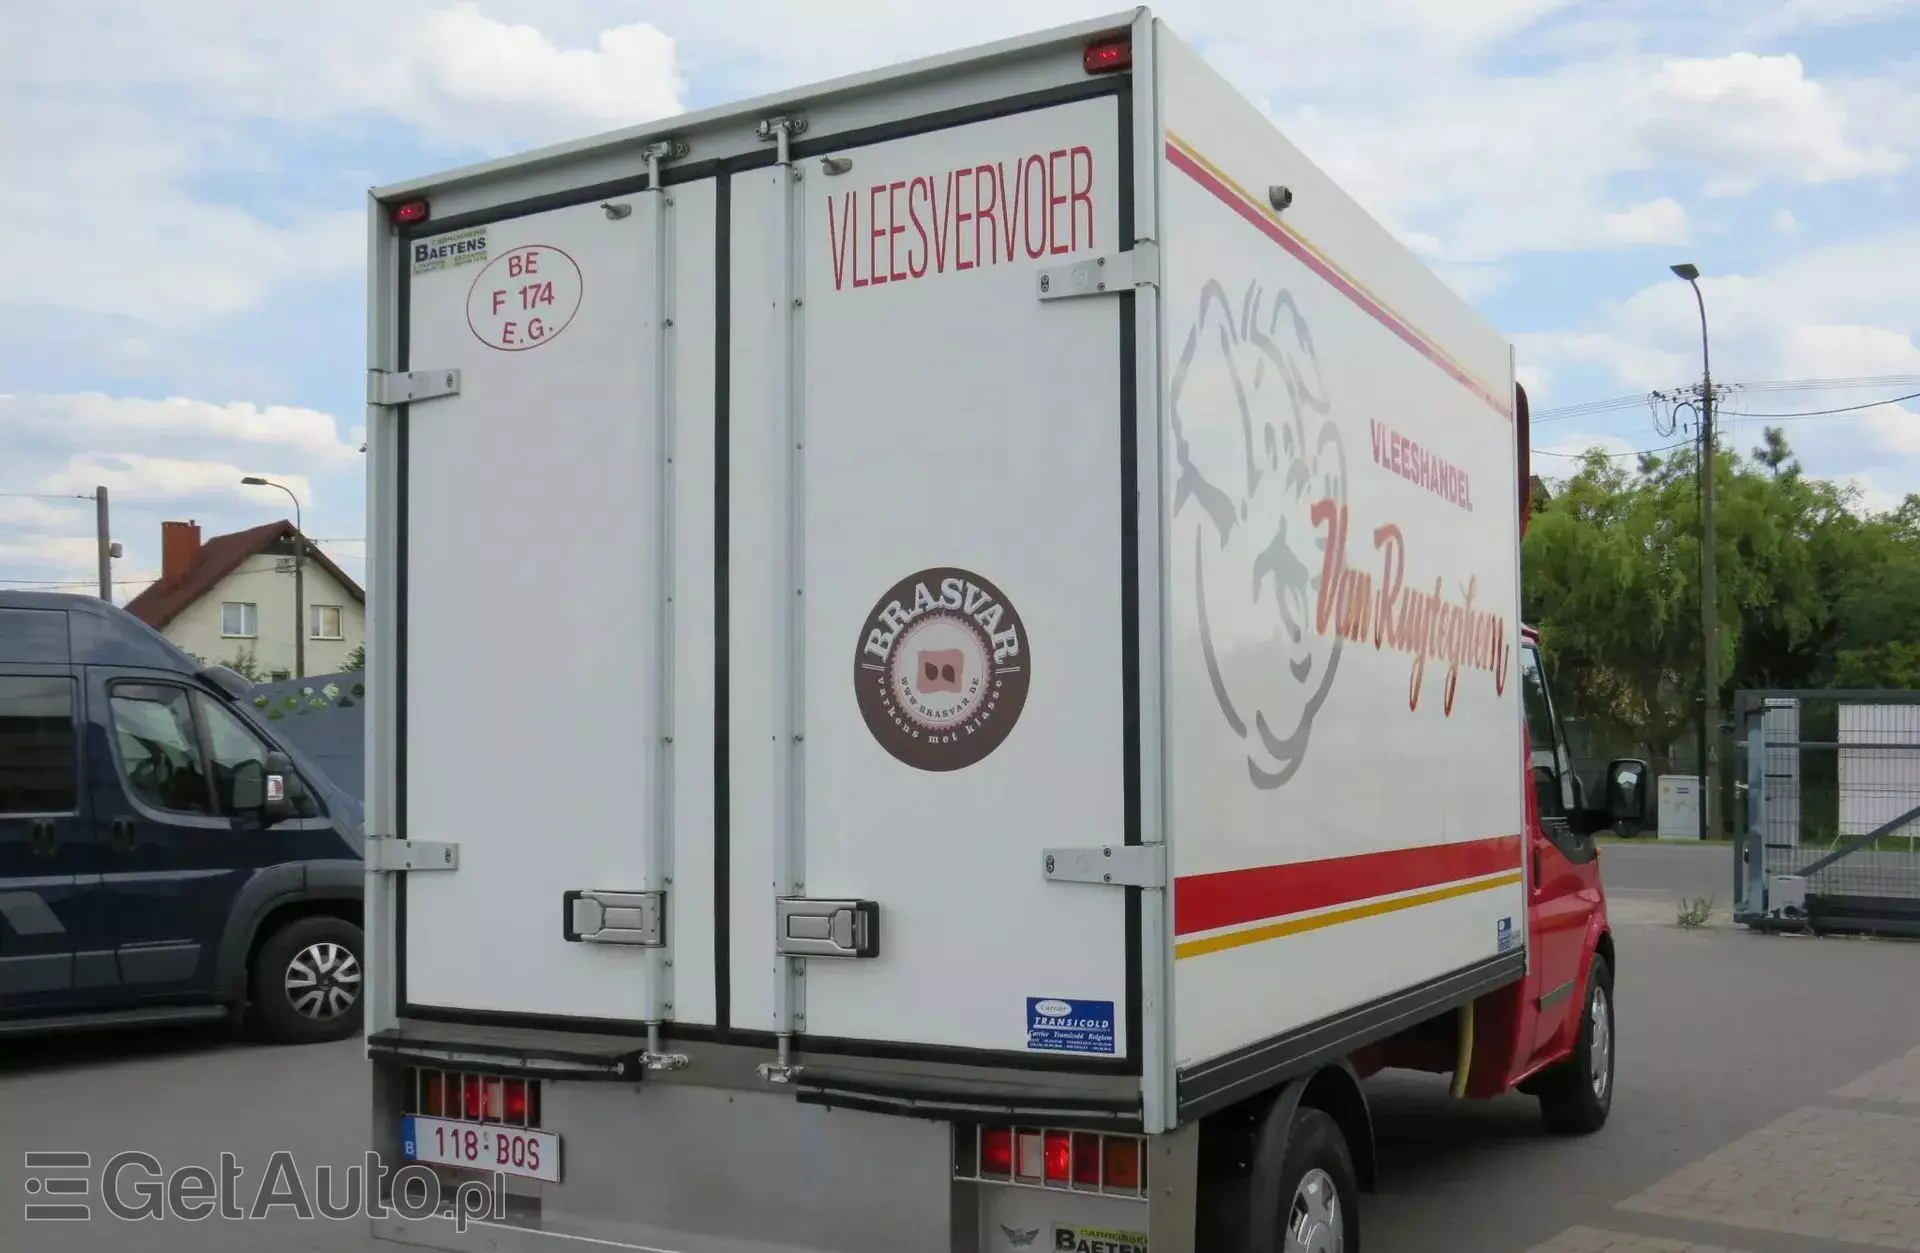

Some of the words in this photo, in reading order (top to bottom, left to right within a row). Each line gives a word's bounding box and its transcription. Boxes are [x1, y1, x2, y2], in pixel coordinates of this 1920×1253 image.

[828, 145, 1094, 290] VLEESVERVOER
[415, 237, 486, 263] BAETENS
[508, 252, 539, 278] BE
[492, 290, 507, 315] F
[519, 281, 555, 310] 174
[502, 318, 553, 344] E.G.
[1370, 418, 1473, 512] VLEESHANDEL
[1310, 497, 1373, 644] Van
[864, 577, 1020, 664] BRASVAR
[928, 731, 958, 744] met
[965, 680, 1002, 735] klasse
[1035, 1017, 1109, 1029] TRANSICOLD
[405, 1141, 414, 1155] B
